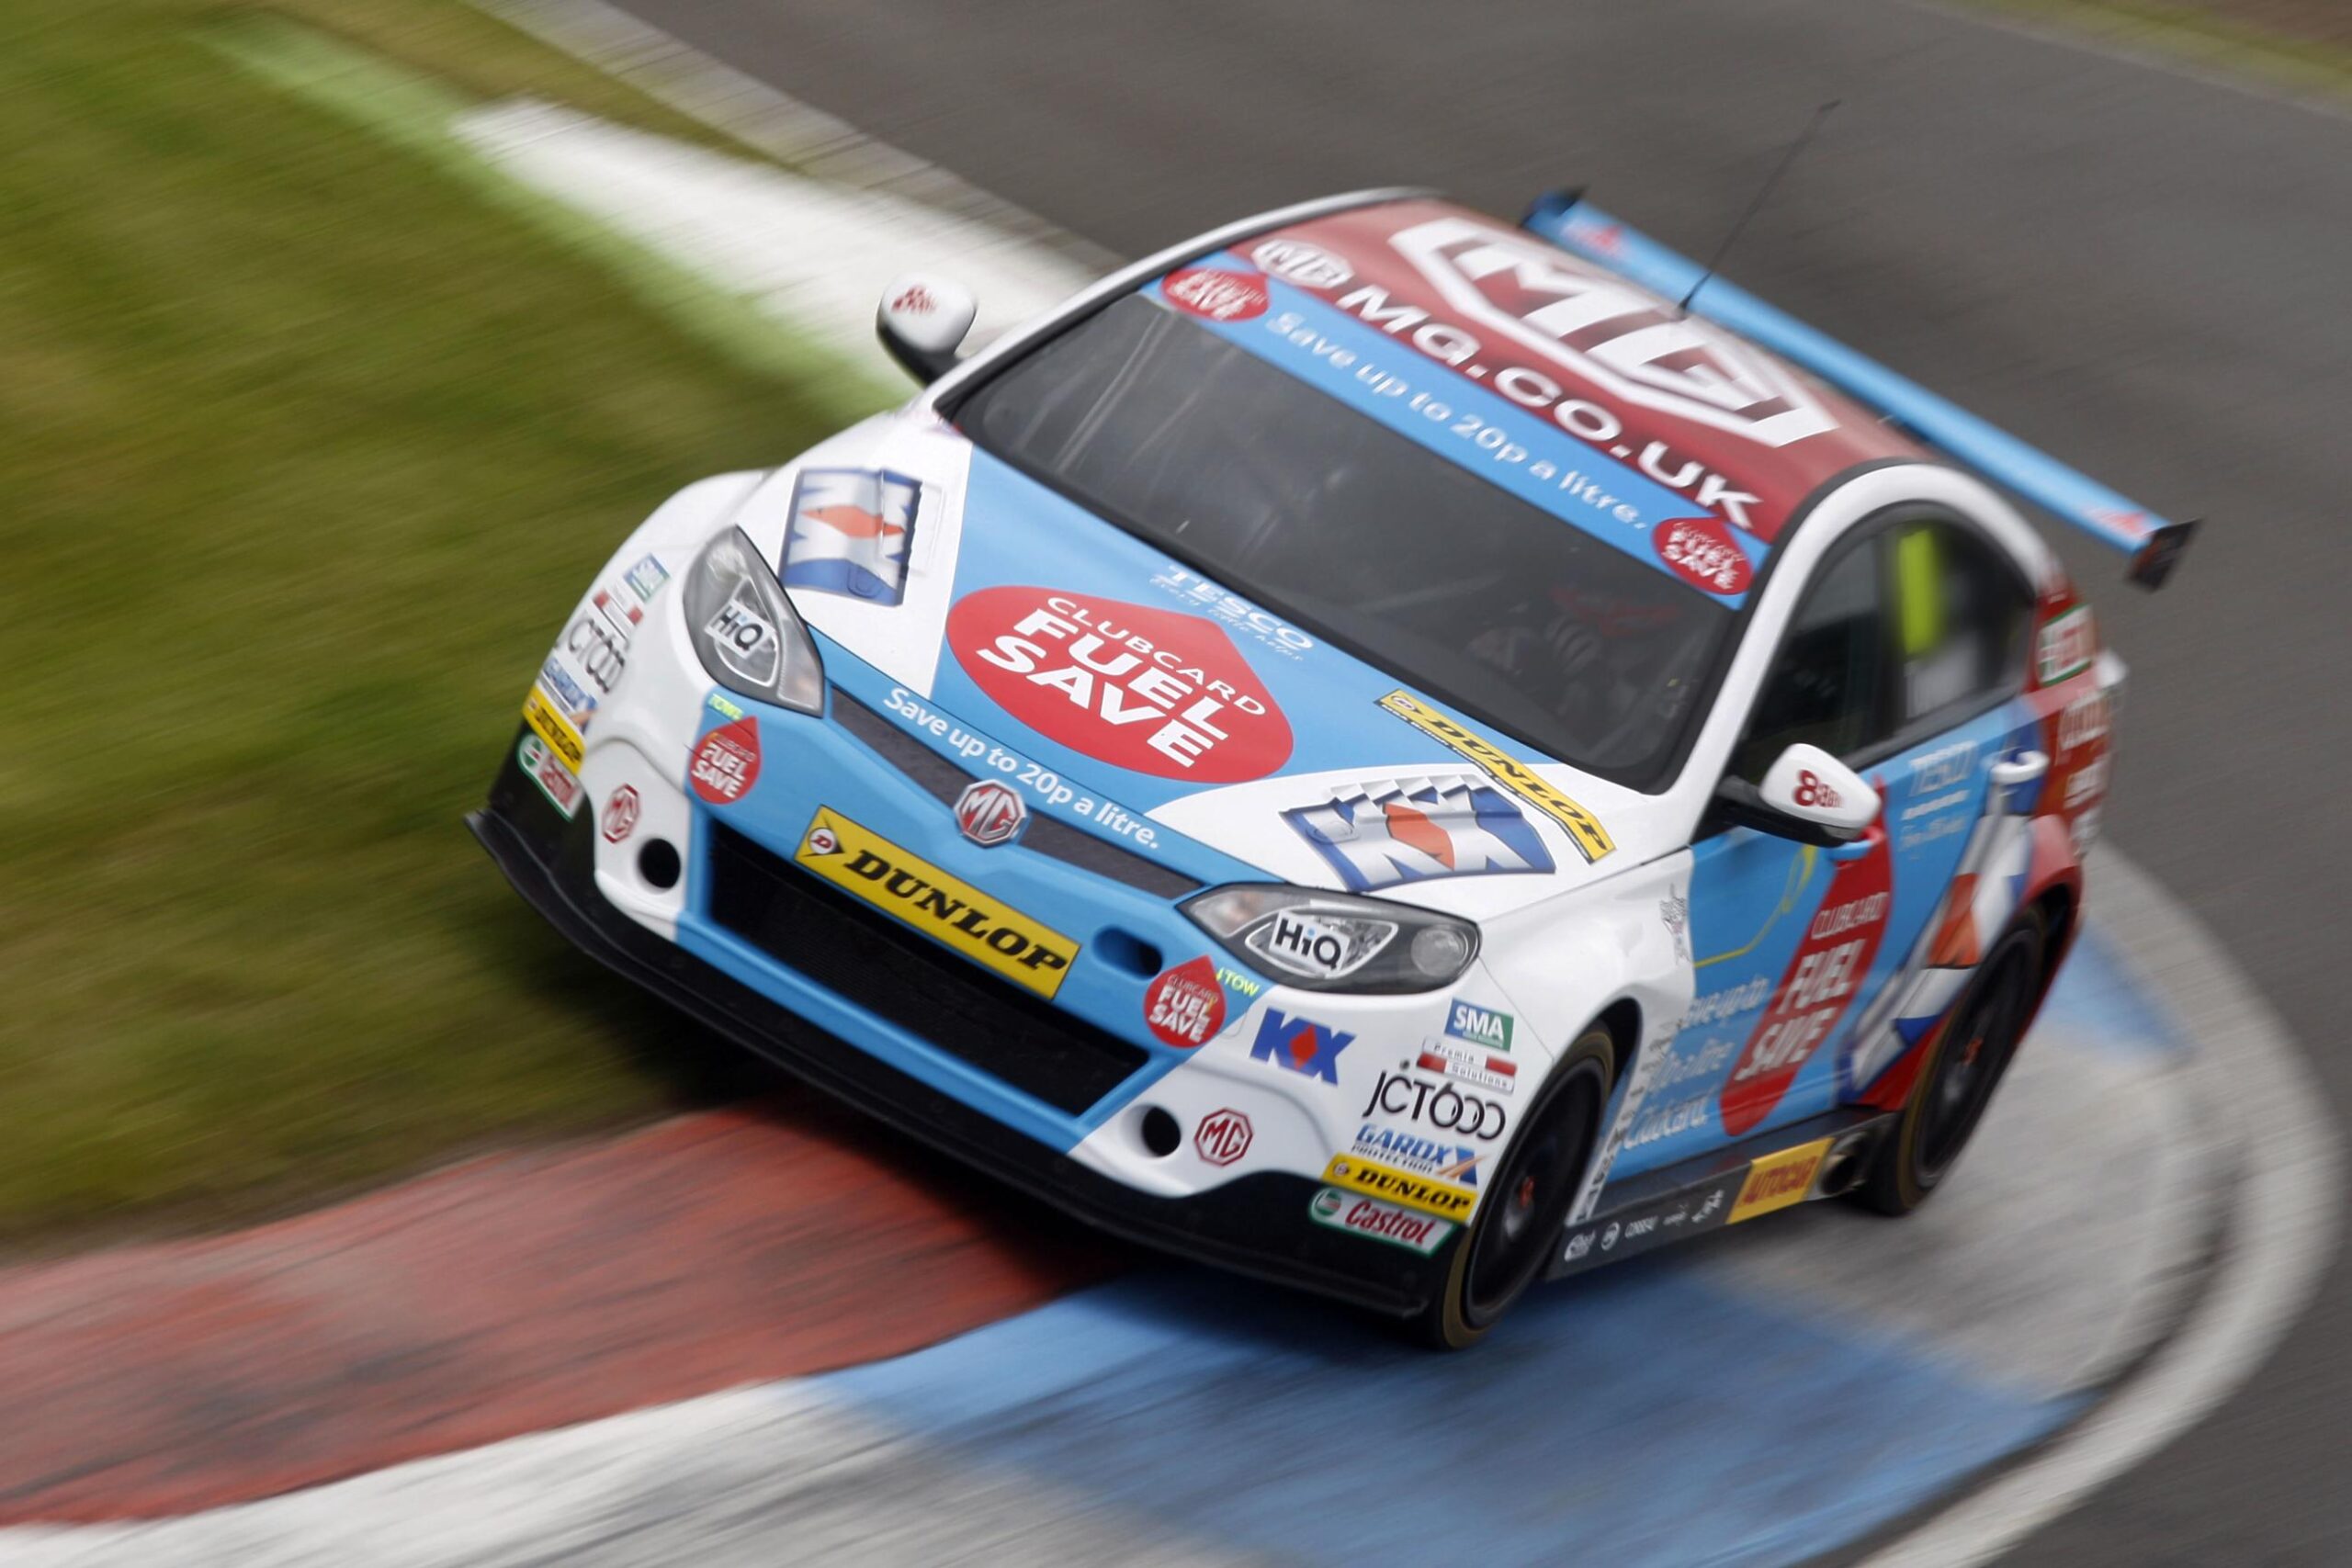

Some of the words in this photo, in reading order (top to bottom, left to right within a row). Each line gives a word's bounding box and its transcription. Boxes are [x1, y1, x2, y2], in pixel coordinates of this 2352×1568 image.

[1266, 312, 1357, 368] Save
[1355, 364, 1408, 397] up
[1408, 391, 1452, 421] to
[1450, 415, 1528, 467] 20p
[1529, 460, 1557, 480] a
[710, 604, 763, 651] HiQ
[1168, 564, 1314, 649] TESCO
[1013, 608, 1228, 740] FUEL
[1047, 597, 1266, 715] CLUBCARD
[976, 636, 1215, 768] SAVE
[691, 760, 744, 799] SAVE
[701, 742, 748, 781] FUEL
[883, 686, 948, 736] Save
[948, 727, 986, 757] up
[986, 747, 1017, 773] to
[1016, 762, 1073, 806] 20p
[1073, 795, 1091, 815] a
[1093, 801, 1159, 849] litre.
[1424, 718, 1608, 851] DUNLOP
[843, 849, 1068, 971] DUNLOP
[1275, 918, 1341, 970] HiQ
[1158, 985, 1211, 1022] FUEL
[1221, 969, 1260, 997] TOW
[1776, 938, 1868, 1015] FUEL
[1149, 1004, 1211, 1043] SAVE
[1453, 1004, 1505, 1042] SMA
[1735, 1007, 1838, 1081] SAVE
[1354, 1168, 1471, 1212] DUNLOP
[1345, 1197, 1438, 1247] Castrol
